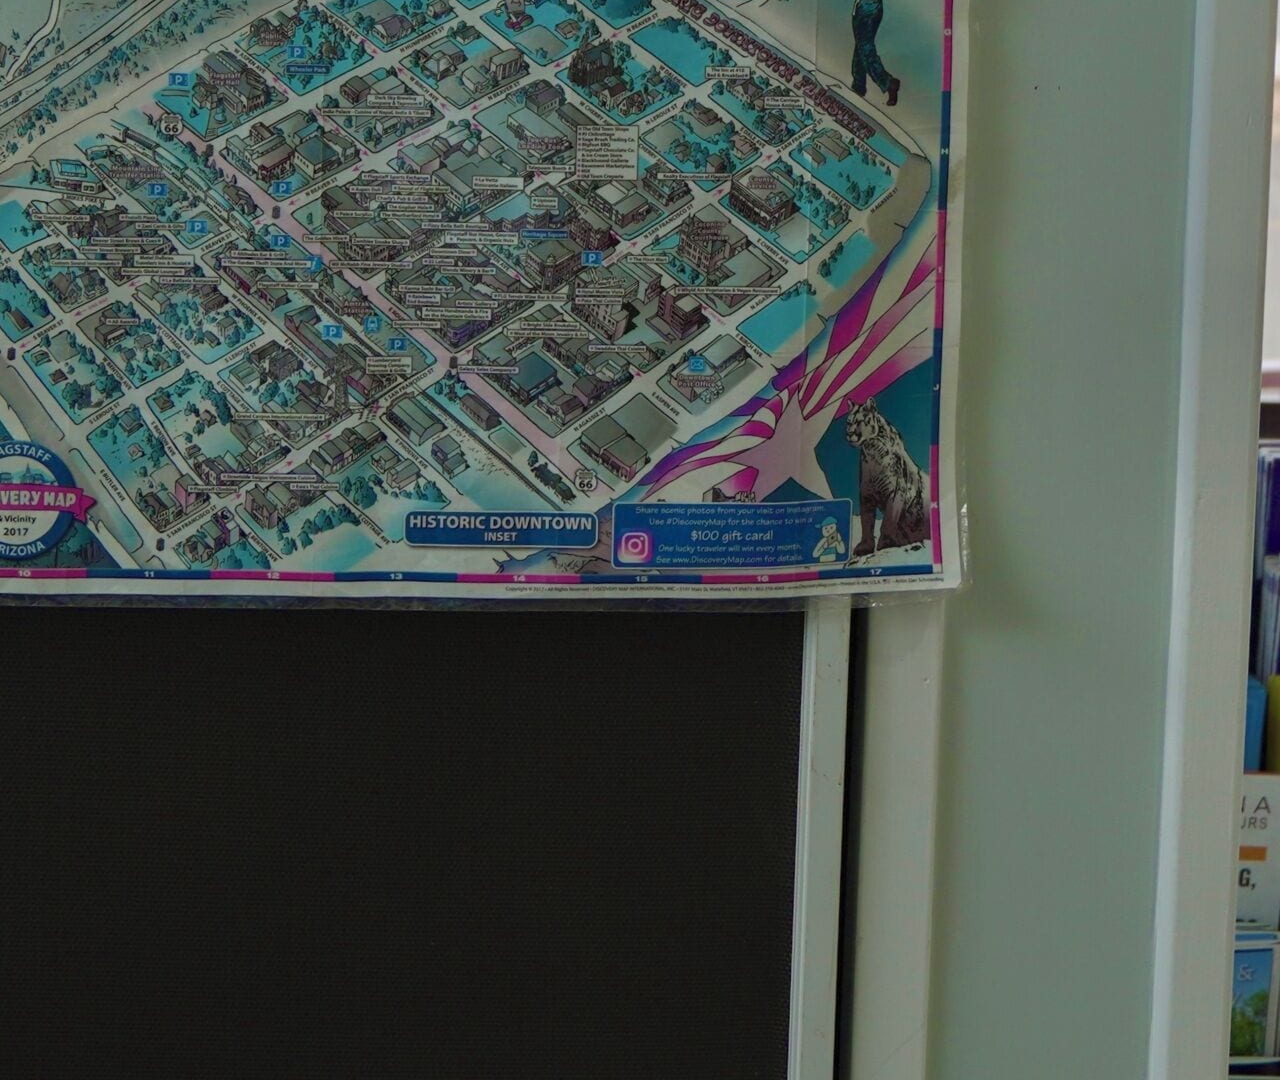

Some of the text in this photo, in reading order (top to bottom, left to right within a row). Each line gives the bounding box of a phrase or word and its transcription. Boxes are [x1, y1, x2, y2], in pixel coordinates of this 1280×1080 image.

[44, 492, 77, 508] MAP
[4, 515, 37, 524] Vicinity
[409, 515, 592, 531] HISTORIC DOWNTOWN
[3, 528, 29, 536] 2017
[484, 532, 518, 542] INSET
[690, 530, 774, 543] $100 gift card!
